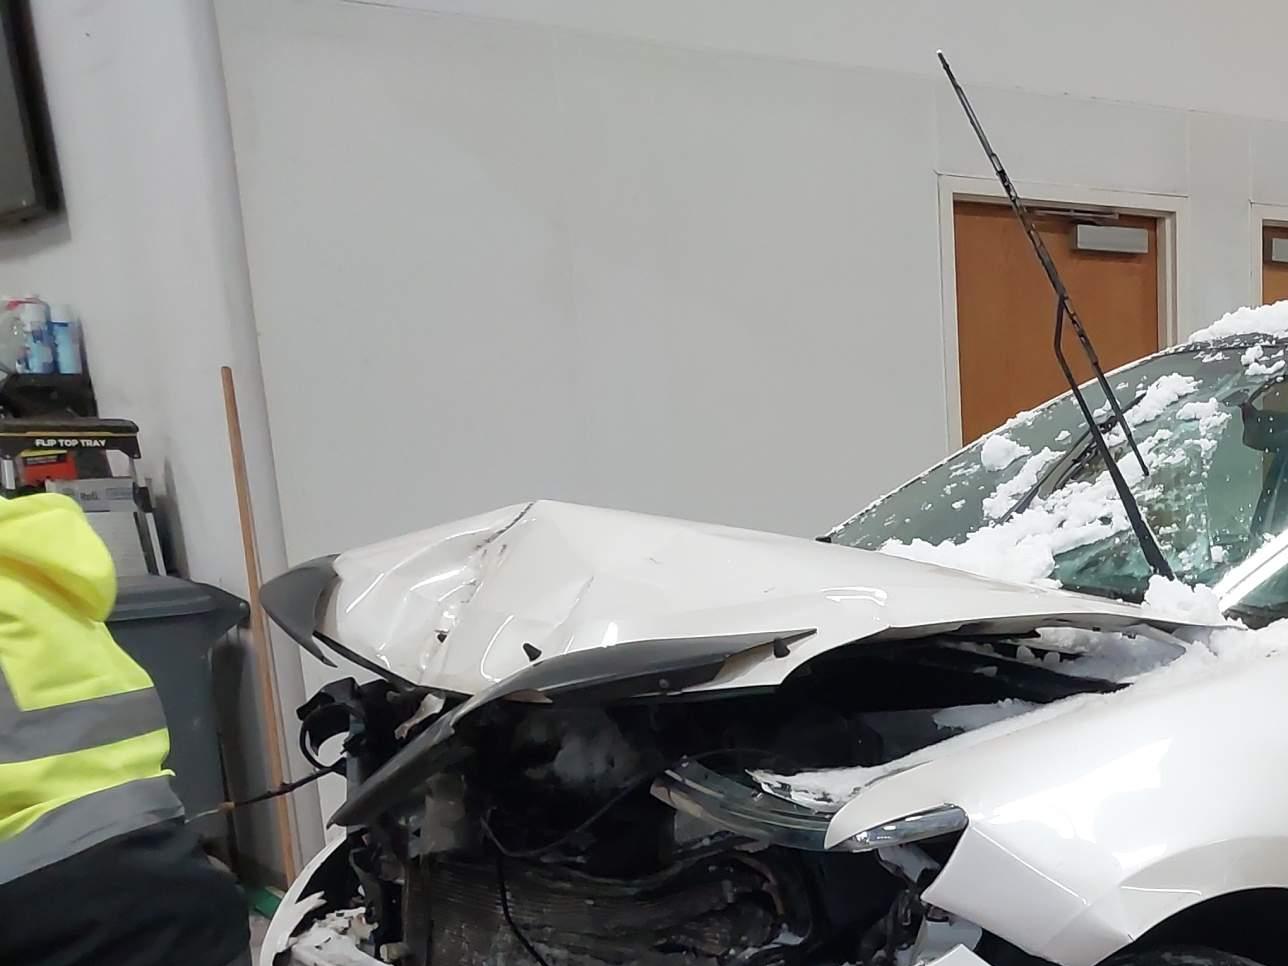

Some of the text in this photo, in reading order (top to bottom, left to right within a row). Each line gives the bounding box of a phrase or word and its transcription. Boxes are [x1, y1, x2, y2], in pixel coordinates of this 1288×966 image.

[35, 439, 106, 447] FLIP TOP TRAY
